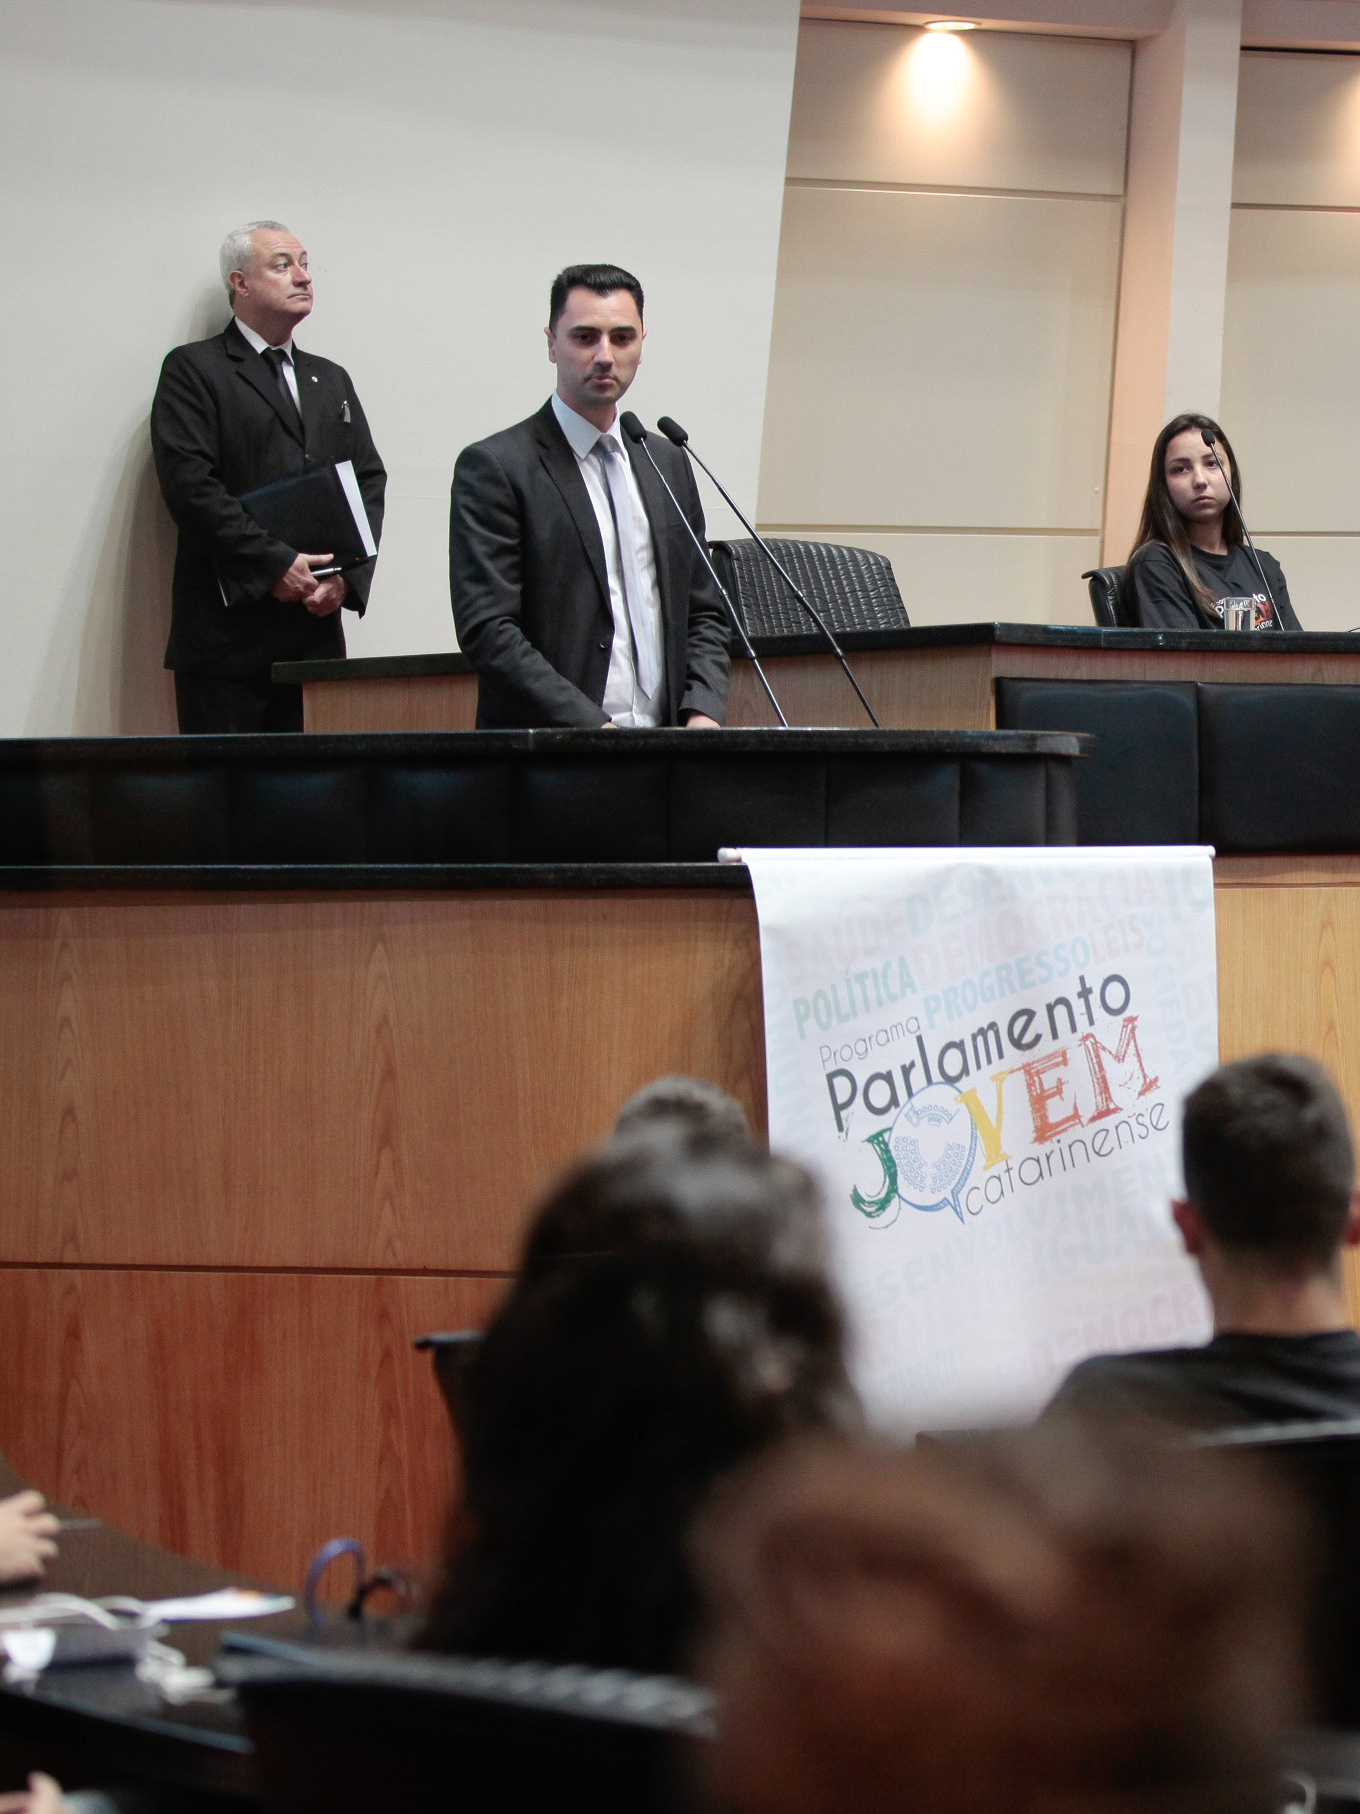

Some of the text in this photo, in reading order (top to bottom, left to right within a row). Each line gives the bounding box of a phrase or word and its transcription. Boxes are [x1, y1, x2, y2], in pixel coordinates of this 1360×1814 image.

[922, 935, 1091, 1031] PROGRESSO
[1088, 912, 1145, 966] LEIS
[793, 955, 918, 1040] POLÍTICA
[818, 1015, 921, 1070] Programa
[824, 972, 1132, 1132] Parlamento
[965, 1102, 1170, 1218] catarinense
